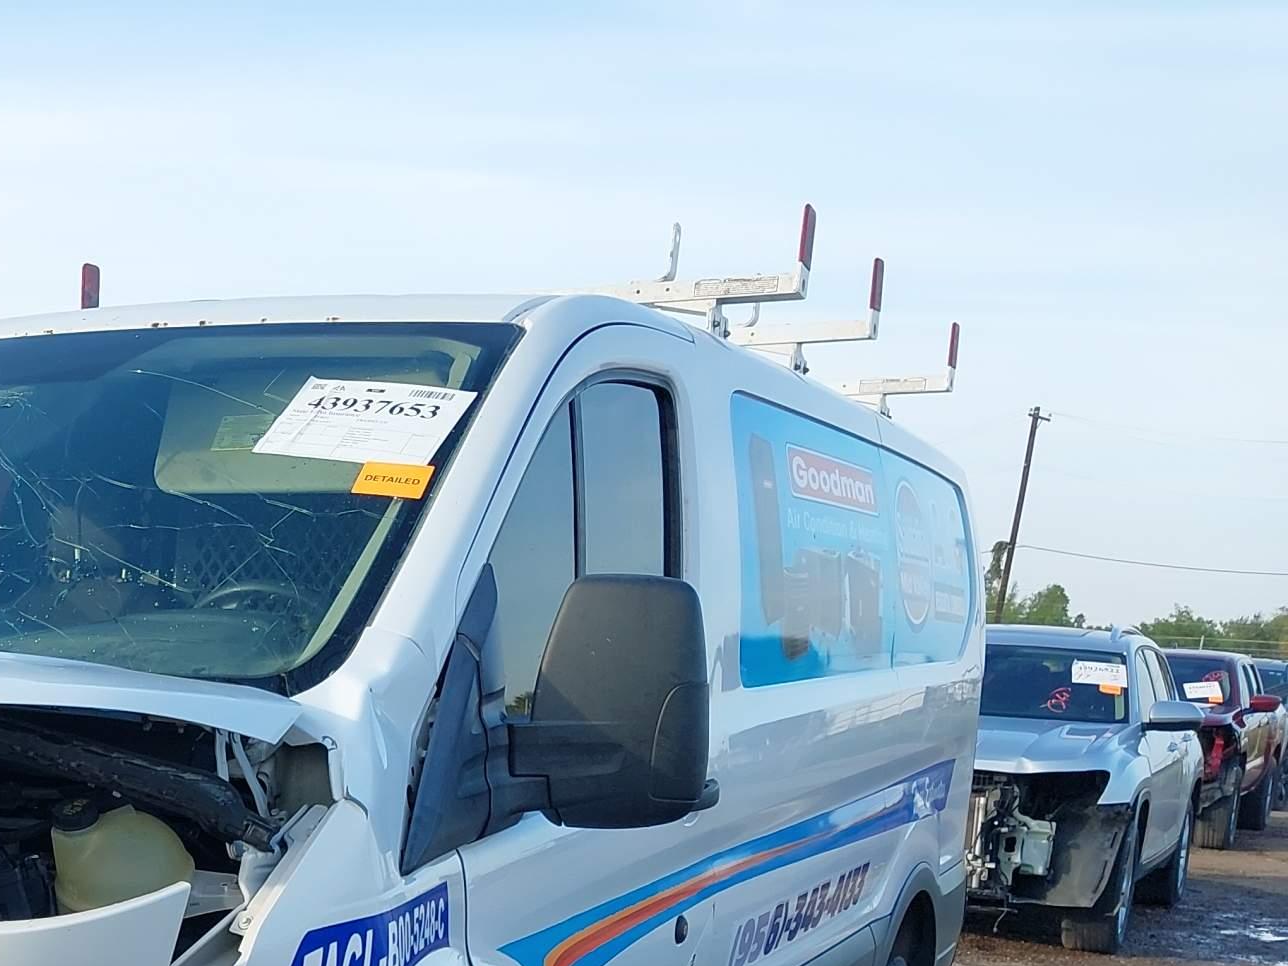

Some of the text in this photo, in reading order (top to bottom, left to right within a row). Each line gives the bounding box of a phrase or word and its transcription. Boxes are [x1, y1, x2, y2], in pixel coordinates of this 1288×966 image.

[308, 395, 441, 420] 43937653
[364, 474, 421, 486] DETAILED
[792, 456, 875, 505] Goodman
